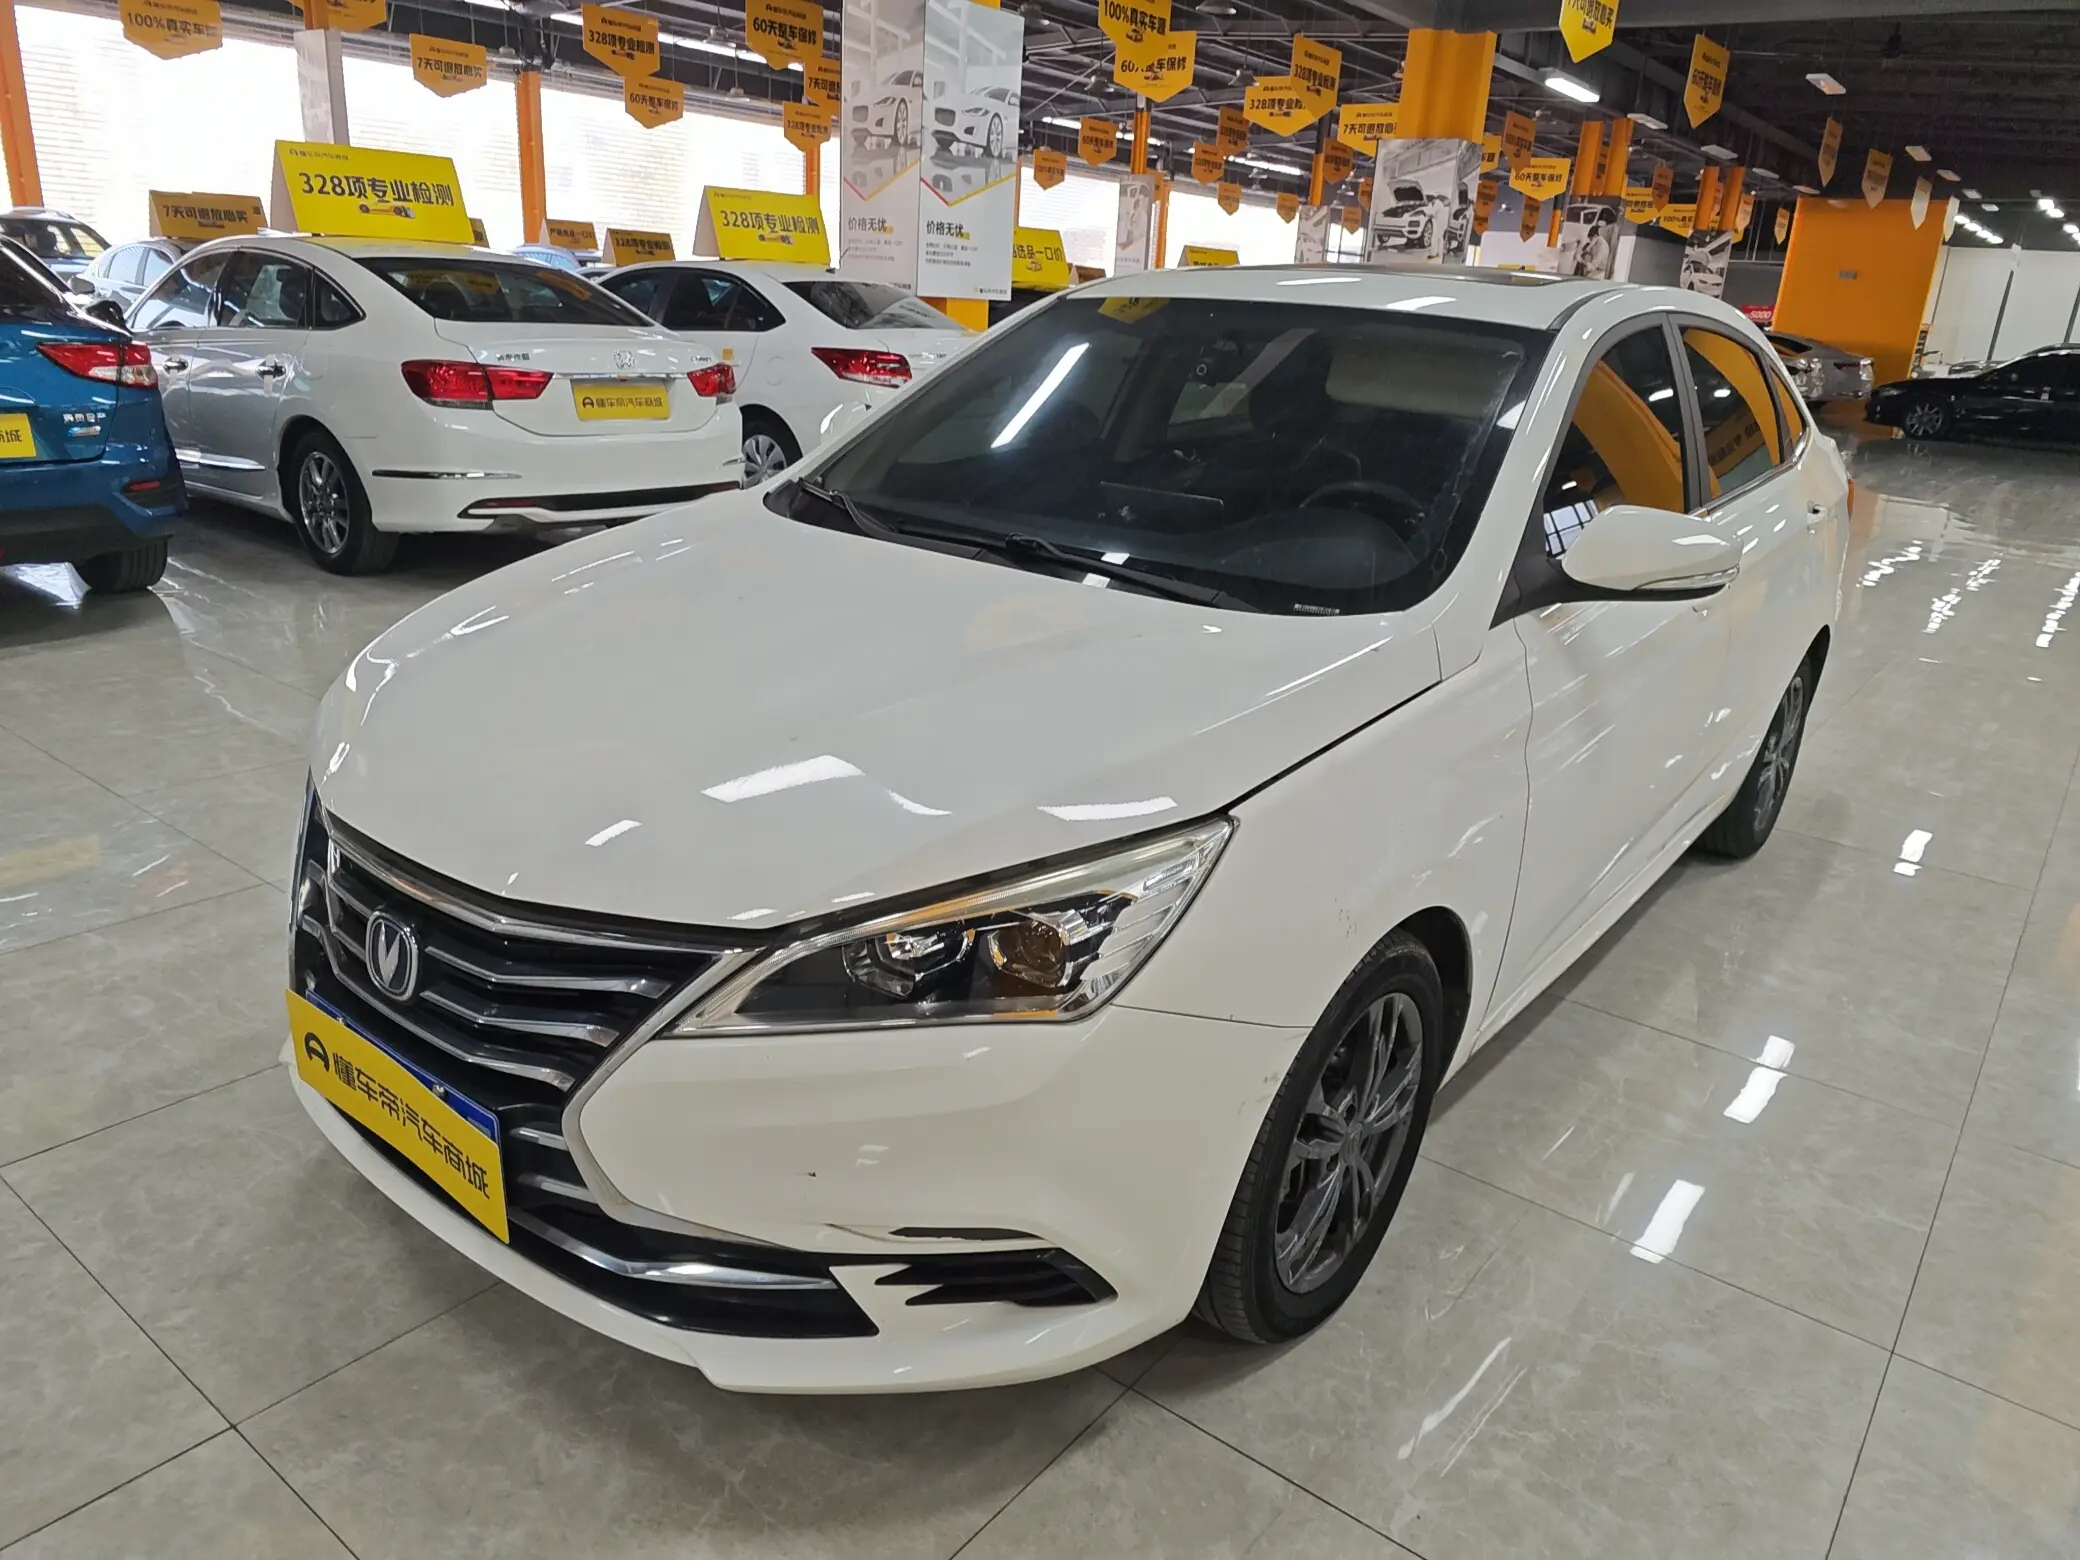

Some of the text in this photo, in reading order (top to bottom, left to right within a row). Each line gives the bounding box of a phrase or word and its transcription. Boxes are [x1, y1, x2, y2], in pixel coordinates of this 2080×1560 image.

[127, 11, 218, 37] 100%真实车源
[752, 16, 817, 46] 60天整车保修
[1104, 0, 1167, 36] 100%真实车源
[588, 29, 656, 55] 328项专业检测
[416, 56, 483, 78] 7天可退放心买
[629, 92, 679, 111] 60天整车保修
[1343, 122, 1398, 135] 7天可退放心
[298, 172, 455, 207] 328项专业检测
[162, 204, 249, 223] 7天可退放心买
[719, 209, 821, 235] 328项专业检测
[926, 219, 965, 238] 价格无忧
[332, 1051, 490, 1200] 懂车帝汽车商城
